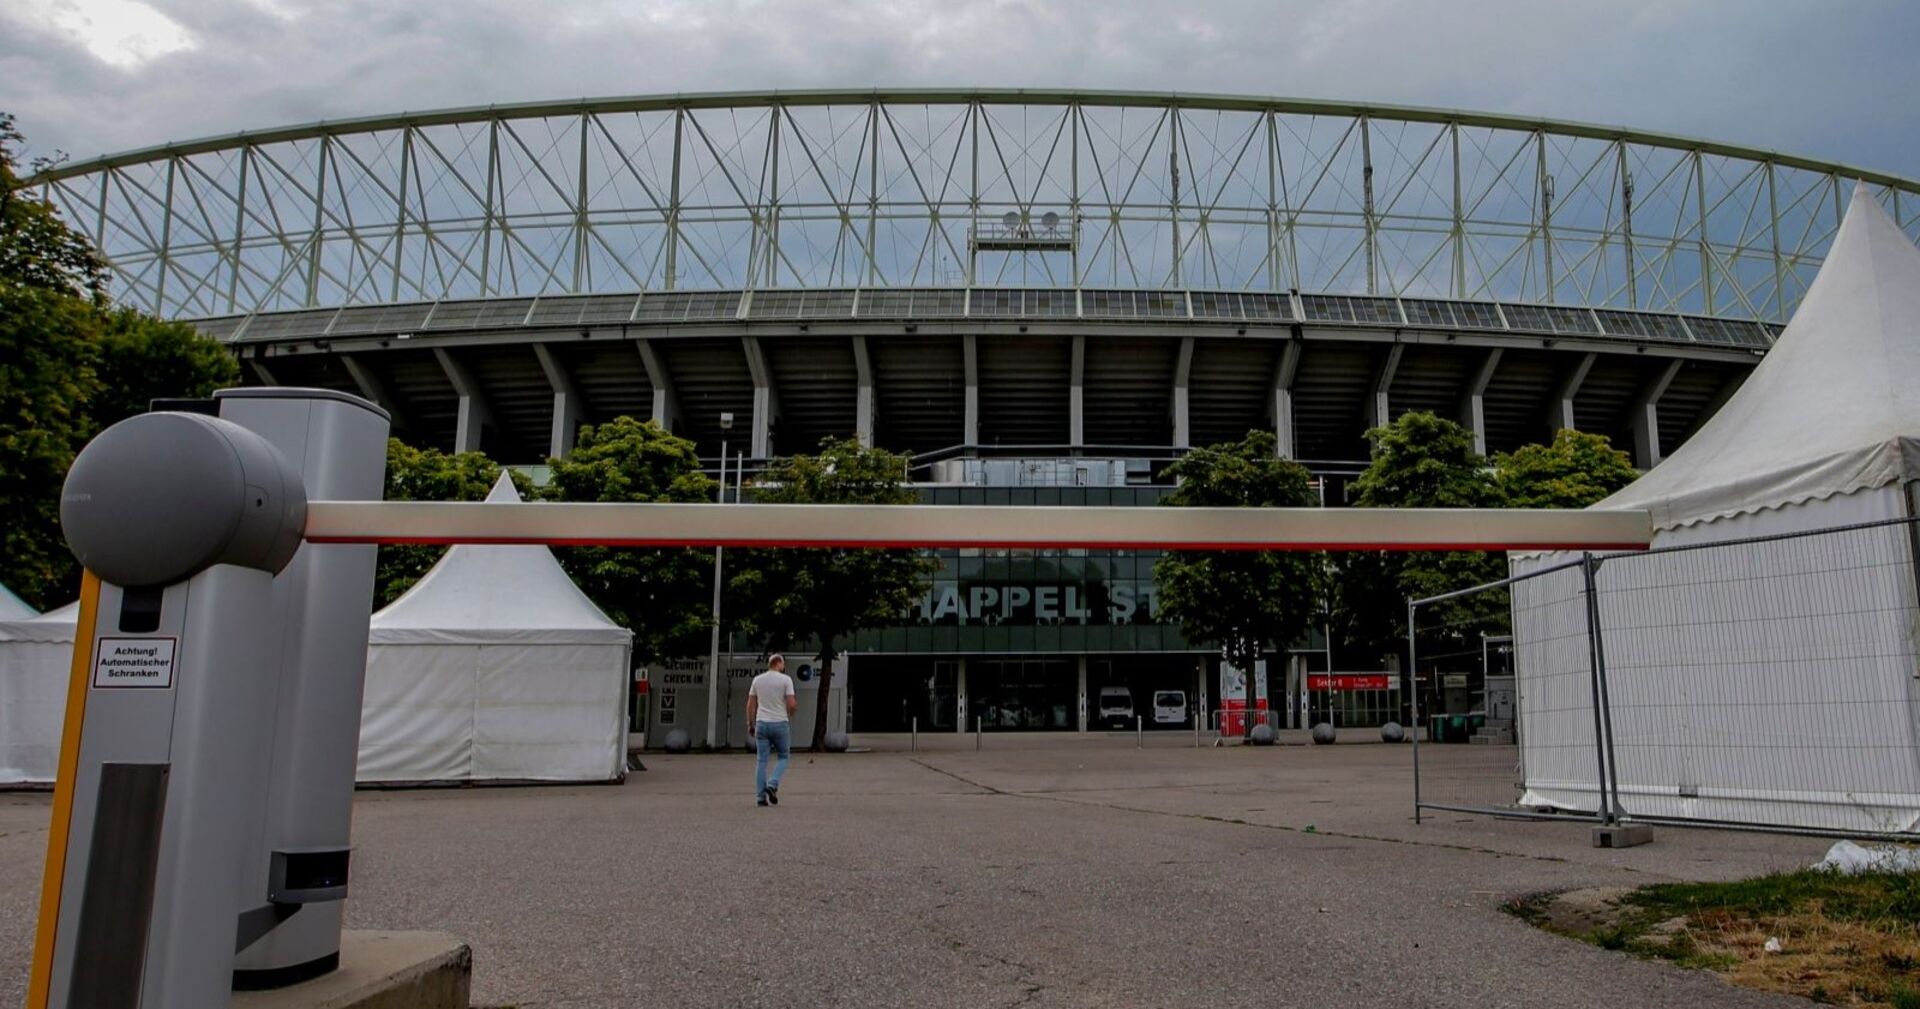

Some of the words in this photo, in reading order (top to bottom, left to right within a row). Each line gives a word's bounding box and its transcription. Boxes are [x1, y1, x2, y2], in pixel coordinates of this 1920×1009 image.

[115, 647, 158, 657] Achtung!
[100, 658, 170, 667] Automatischer
[108, 669, 159, 678] Schranken
[664, 674, 692, 684] CHECK
[694, 674, 704, 684] IN
